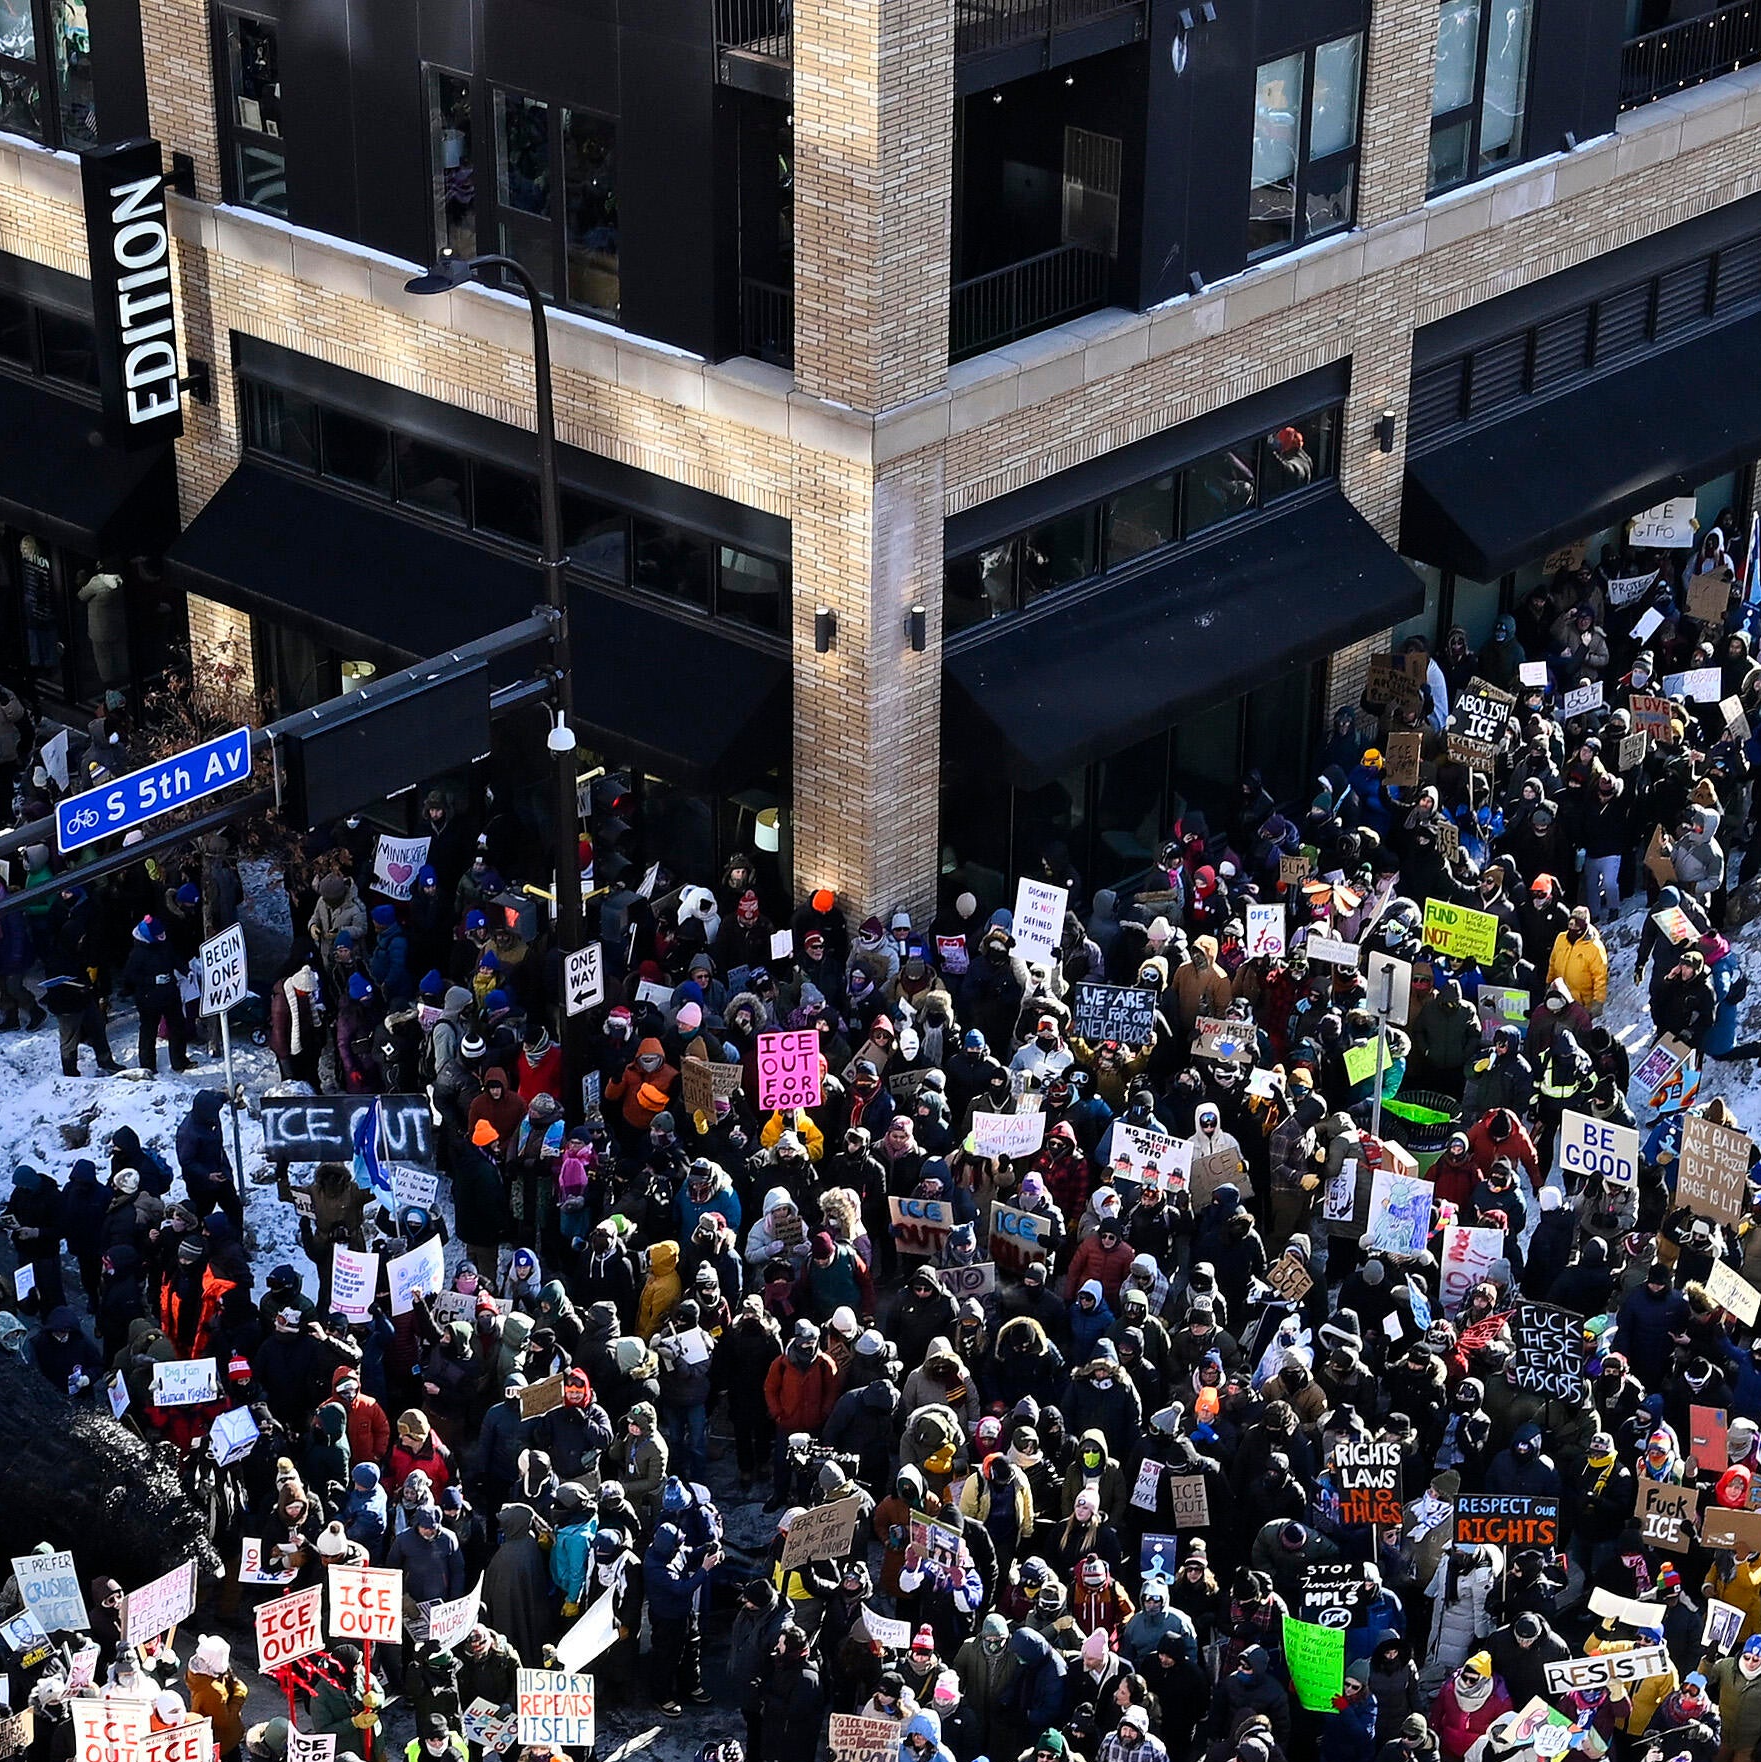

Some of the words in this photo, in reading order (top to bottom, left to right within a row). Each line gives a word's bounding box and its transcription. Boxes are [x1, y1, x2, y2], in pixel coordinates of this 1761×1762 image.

[110, 176, 180, 424] EDITION
[1456, 695, 1509, 723] ABOLISH
[1631, 694, 1671, 714] LOVE
[1469, 714, 1497, 741] ICE
[107, 791, 128, 820] S
[140, 767, 190, 808] 5th
[204, 748, 241, 783] Av
[378, 843, 428, 862] MINNESOTA
[1029, 887, 1057, 901] DIGNITY
[1024, 916, 1052, 930] DEFINED
[1427, 904, 1457, 924] FUND
[1424, 926, 1451, 945] NOT
[206, 934, 240, 969] BEGIN
[571, 950, 596, 973] ONE
[212, 958, 240, 985] ONE
[571, 965, 596, 989] WAY
[210, 984, 240, 1006] WAY
[761, 1034, 812, 1050] ICE
[762, 1055, 813, 1075] OUT
[766, 1076, 811, 1093] FOR
[763, 1091, 815, 1107] GOOD
[1584, 1123, 1614, 1152] BE
[1566, 1144, 1631, 1181] GOOD
[898, 1198, 942, 1221] ICE
[1519, 1306, 1581, 1335] FUCK
[1519, 1328, 1581, 1358] THESE
[1520, 1350, 1581, 1376] TEMU
[1516, 1367, 1581, 1403] FASCISTS
[1335, 1443, 1401, 1466] RIGHTS
[1342, 1469, 1396, 1488] LAWS
[1341, 1500, 1402, 1524] THUGS
[1459, 1498, 1531, 1514] RESPECT
[1535, 1506, 1556, 1516] OUR
[1458, 1518, 1556, 1544] RIGHTS
[1643, 1514, 1682, 1542] ICE
[1307, 1564, 1352, 1575] STOP
[341, 1586, 391, 1607] ICE
[1305, 1591, 1358, 1606] MPLS
[262, 1615, 306, 1641] ICE
[340, 1611, 395, 1634] OUT!
[262, 1628, 315, 1661] OUT!
[1549, 1649, 1667, 1693] RESIST!
[520, 1673, 593, 1693] HISTORY
[521, 1694, 592, 1716] REPEATS
[523, 1719, 588, 1745] ITSELF
